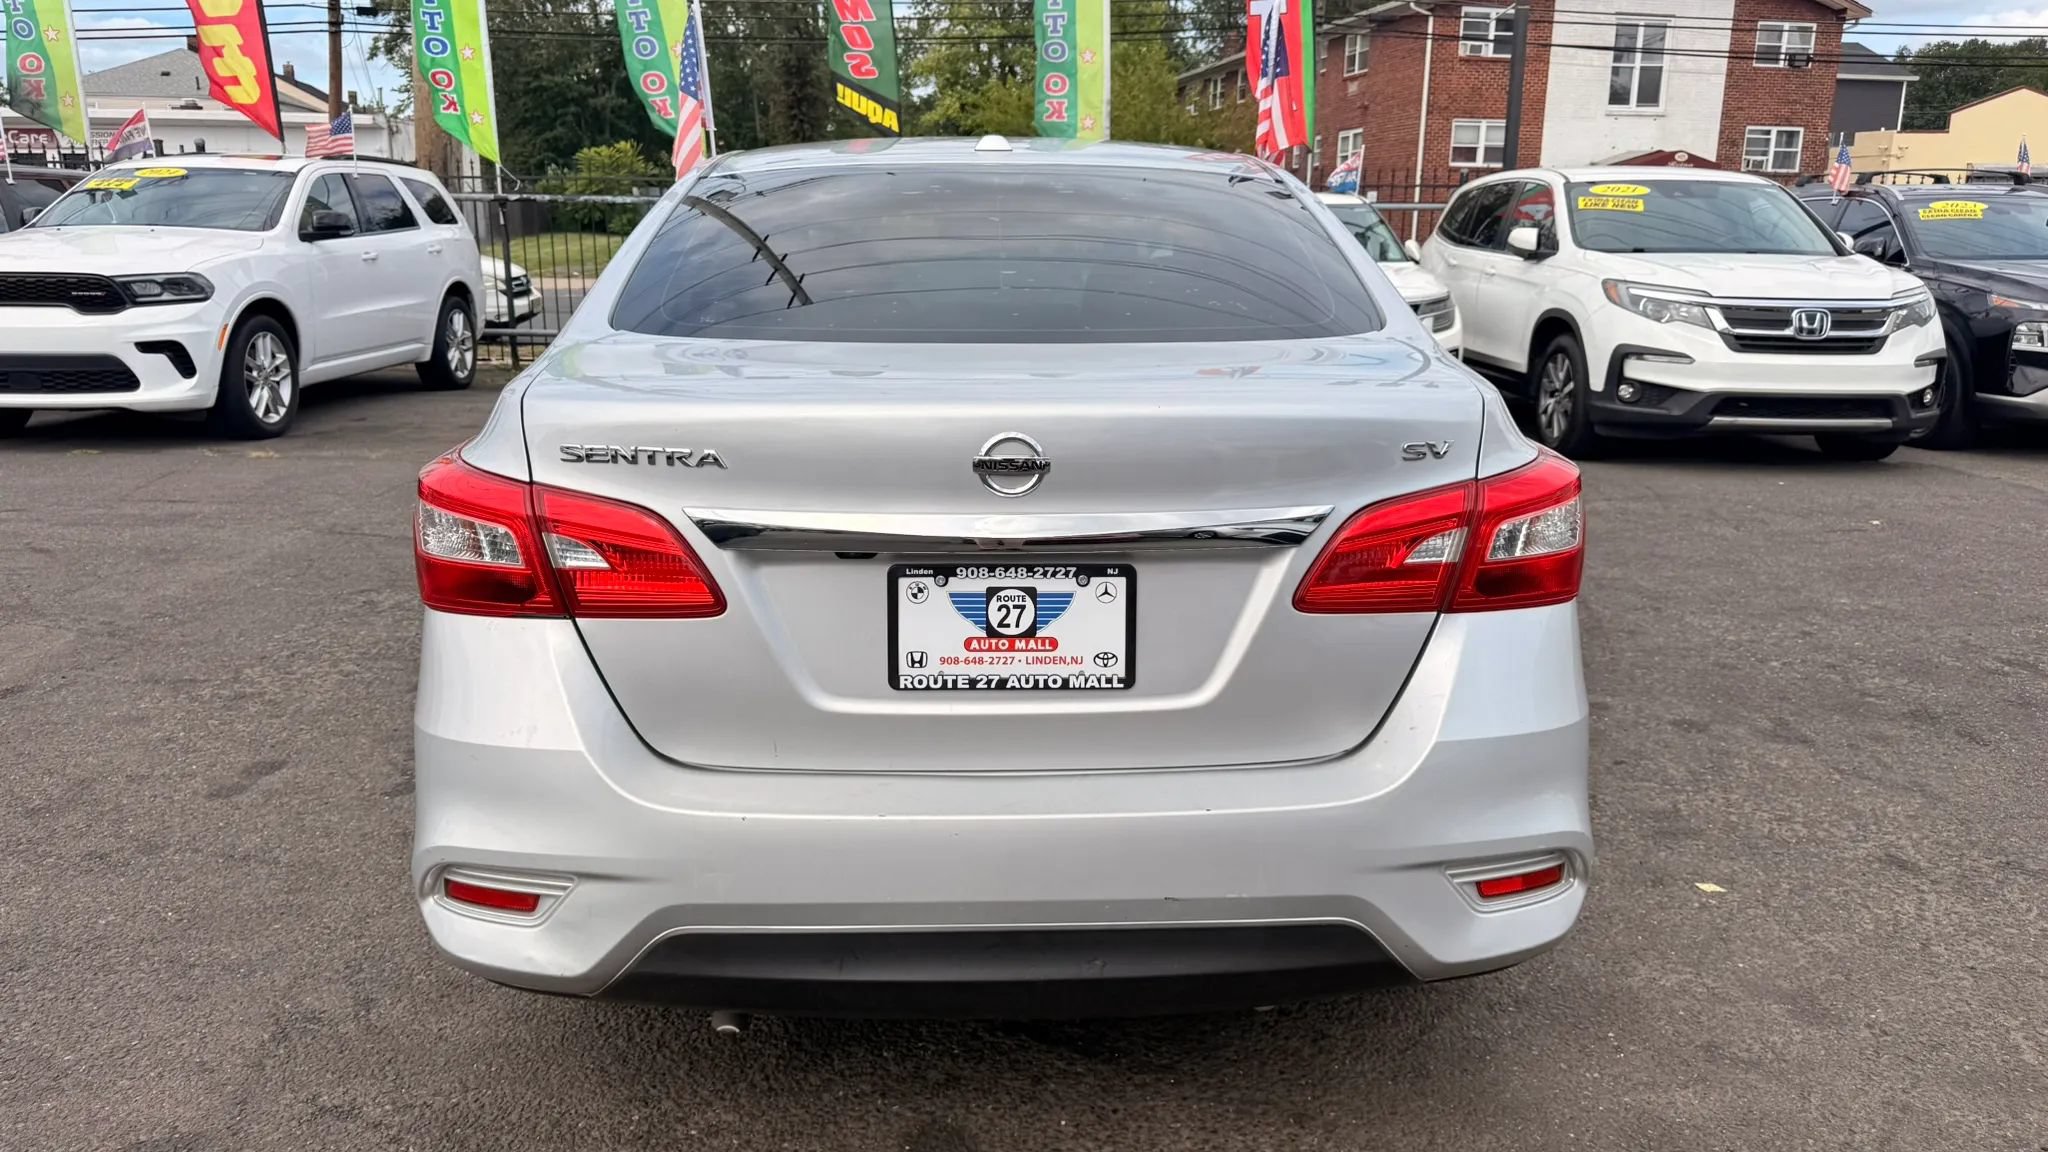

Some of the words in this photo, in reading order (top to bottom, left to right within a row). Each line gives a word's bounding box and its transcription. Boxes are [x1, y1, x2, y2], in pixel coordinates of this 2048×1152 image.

[560, 443, 728, 469] SENTRA
[1402, 440, 1453, 461] SV
[980, 459, 1045, 472] NISSAN
[956, 567, 1077, 579] 908-648-2727
[996, 595, 1027, 603] ROUTE
[997, 604, 1027, 629] 27
[969, 639, 1010, 650] AUTO
[1015, 639, 1053, 650] MALL
[939, 656, 1015, 666] 908-648-2727
[1025, 656, 1084, 667] LINDEN,NJ
[899, 674, 970, 689] ROUTE
[972, 674, 1000, 689] 27
[1006, 674, 1063, 689] AUTO
[1068, 674, 1125, 689] MALL
